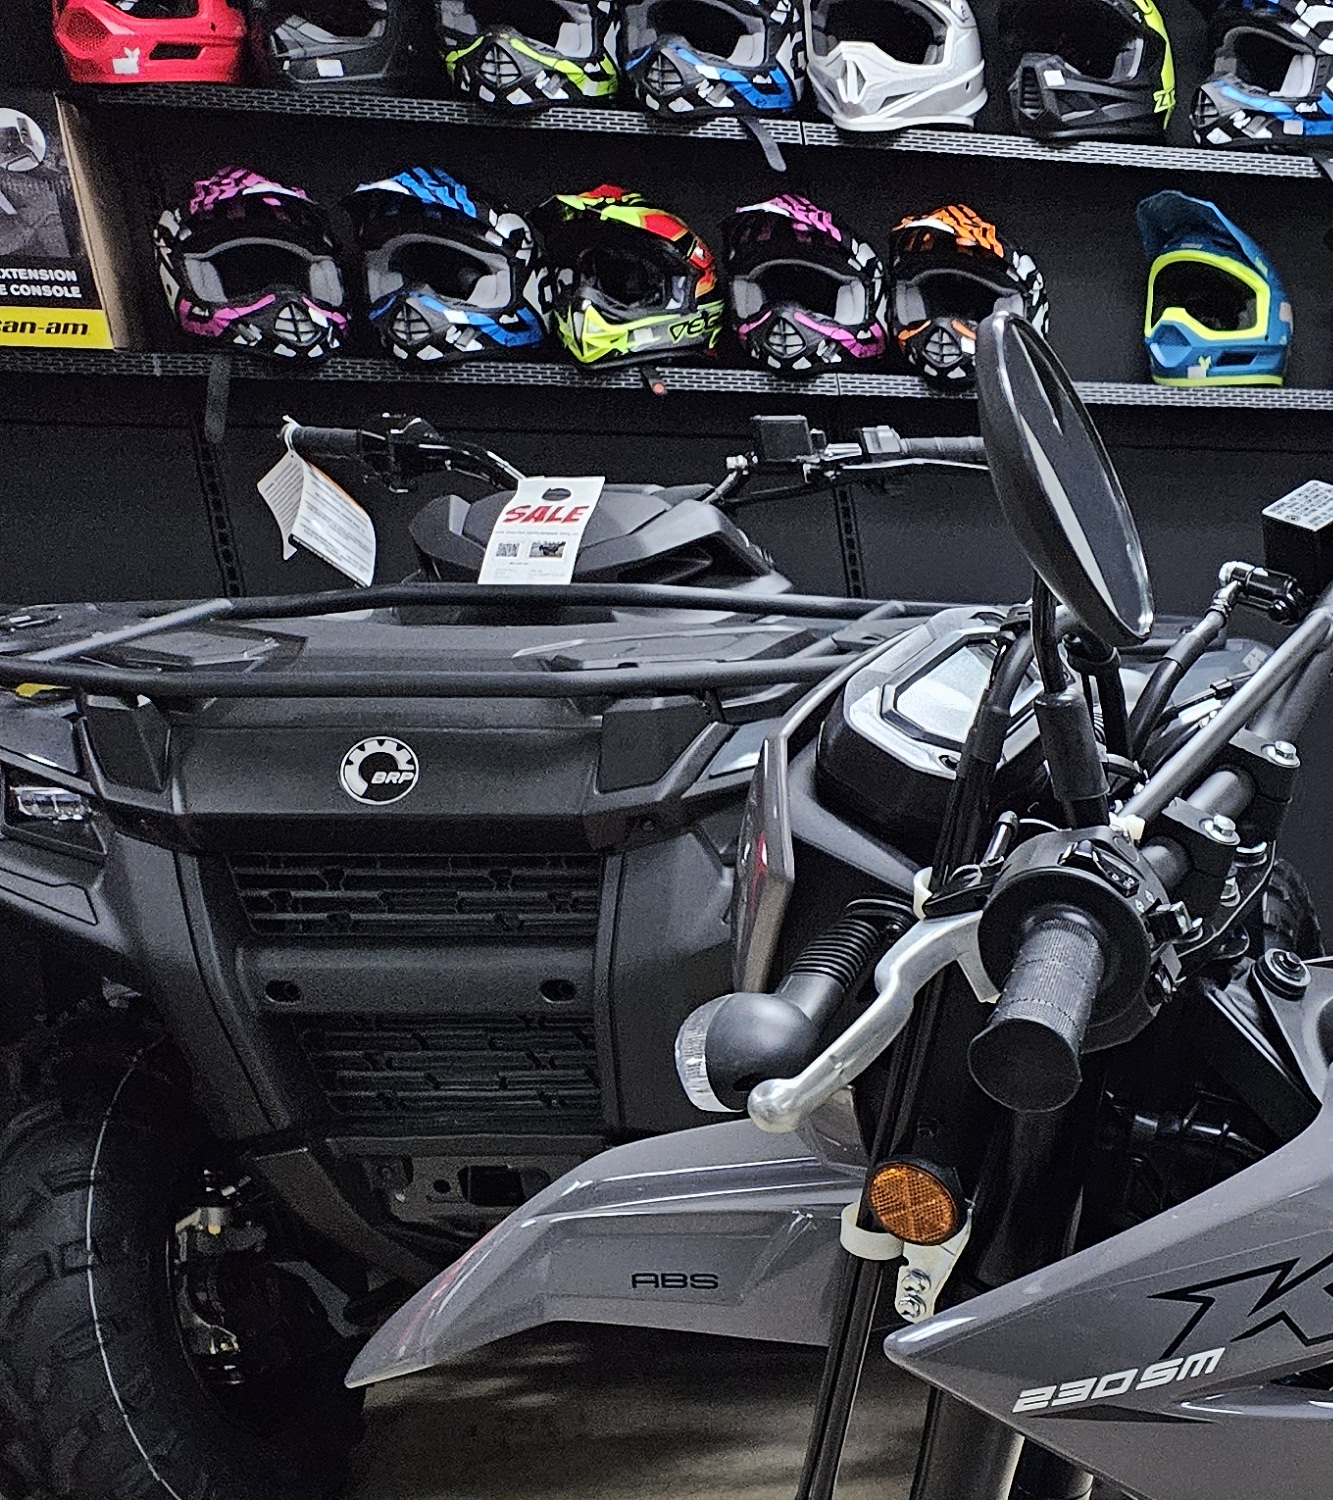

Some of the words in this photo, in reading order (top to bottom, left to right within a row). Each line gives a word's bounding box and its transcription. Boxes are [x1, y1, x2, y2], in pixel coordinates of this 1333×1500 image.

[10, 284, 82, 298] CONSOLE
[0, 321, 88, 335] an-am
[502, 504, 590, 524] SALE
[370, 771, 415, 784] BRP
[631, 1272, 719, 1289] ABS
